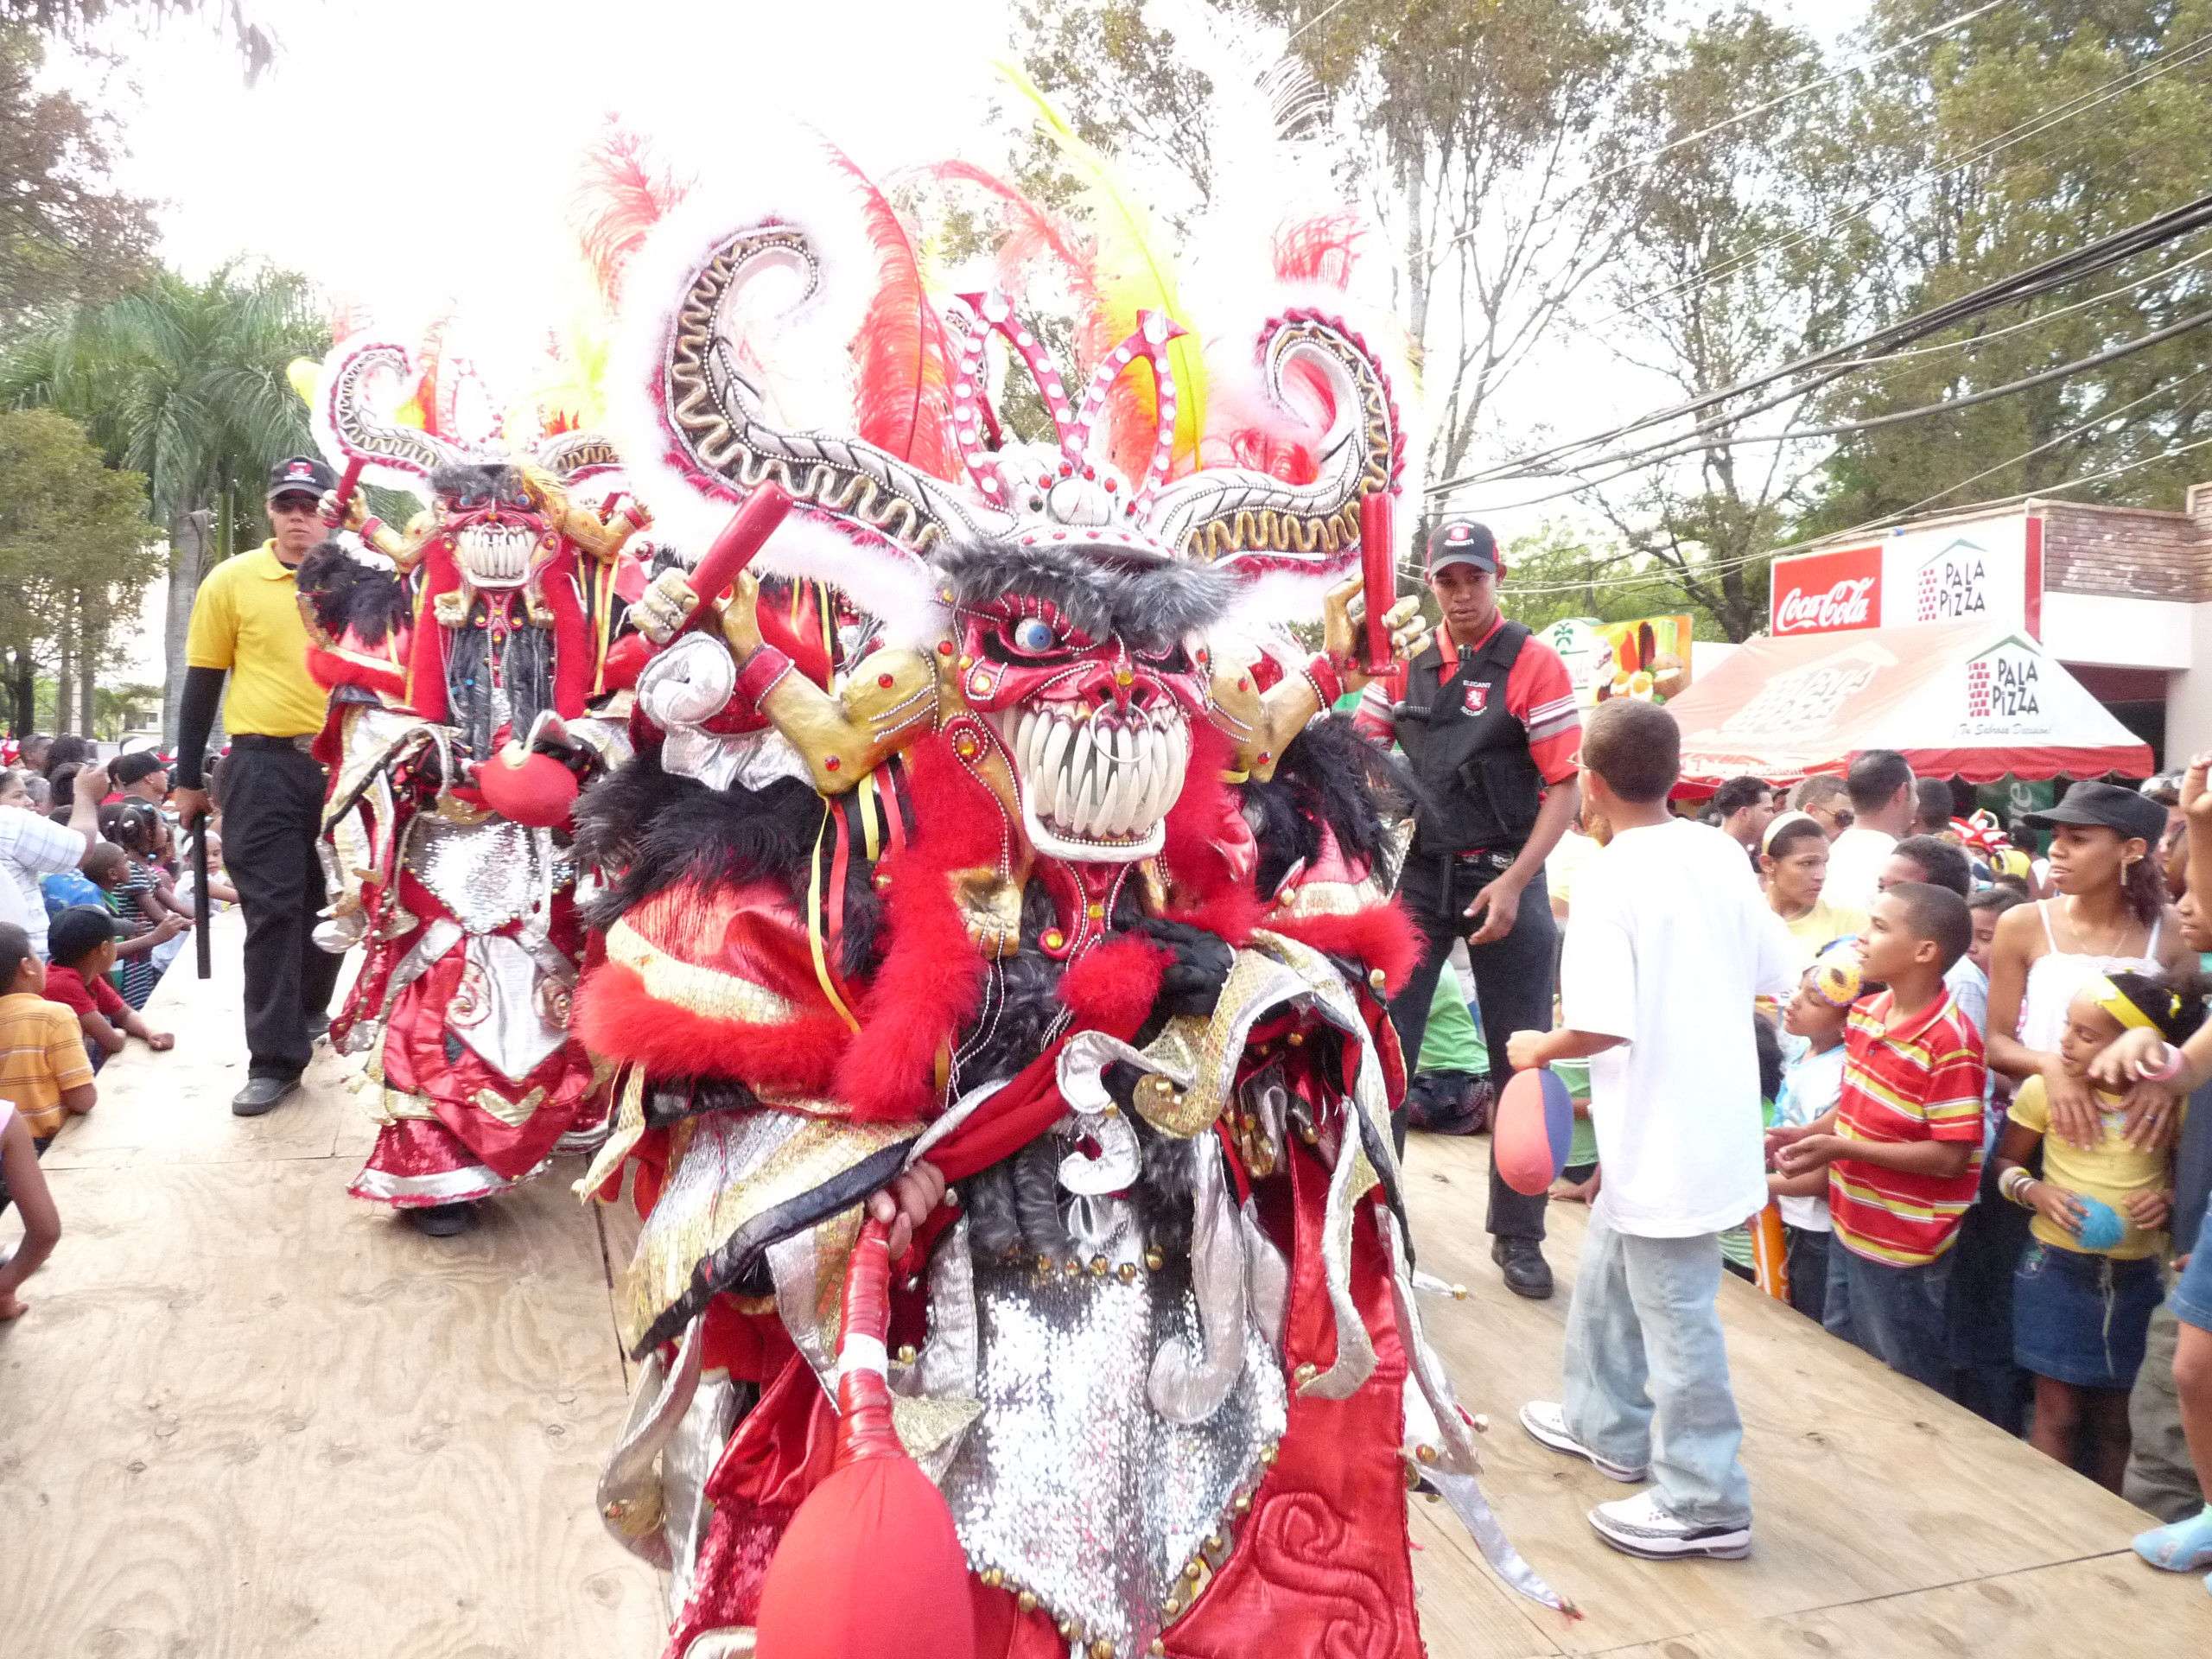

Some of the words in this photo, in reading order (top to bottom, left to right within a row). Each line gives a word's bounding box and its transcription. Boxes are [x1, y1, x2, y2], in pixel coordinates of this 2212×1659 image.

[1946, 559, 1986, 588] PALA
[1776, 576, 1876, 632] Coca-Cola
[1940, 586, 1986, 617] PIZZA
[1997, 658, 2038, 688] PALA
[1992, 684, 2040, 716] PIZZA
